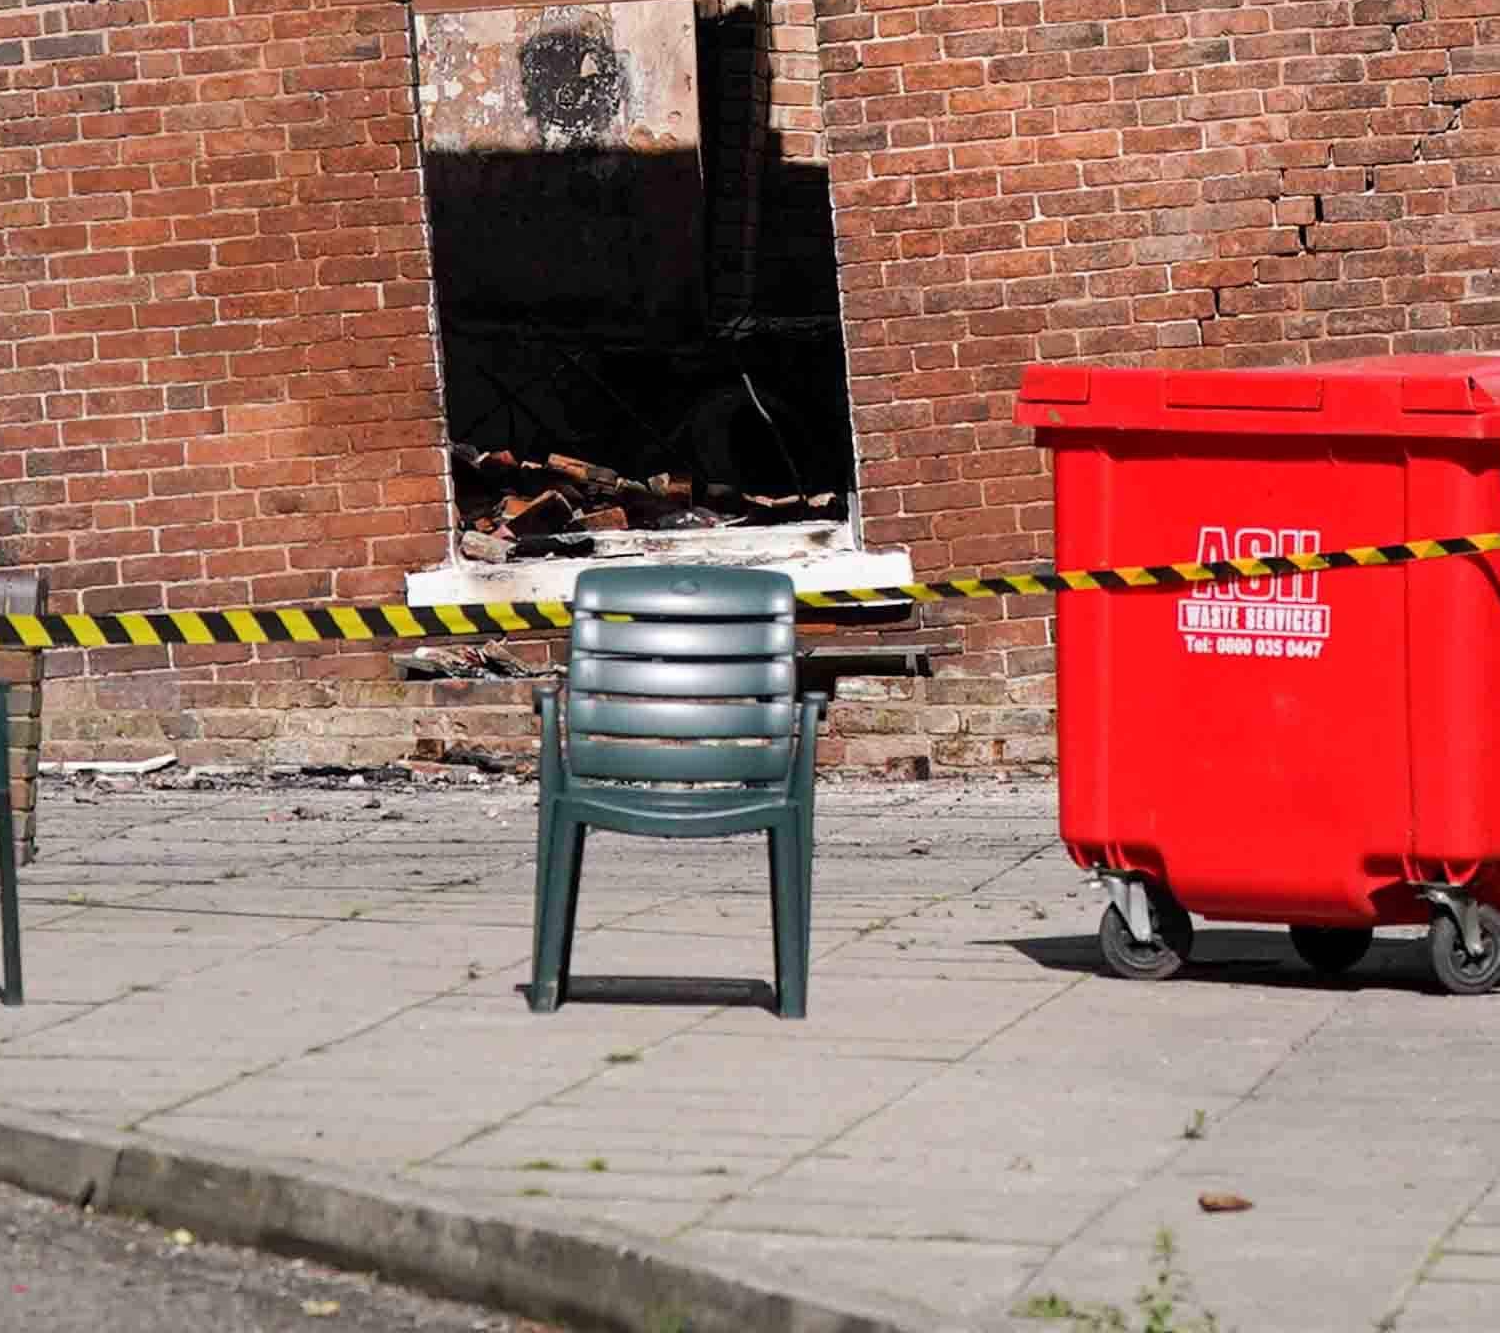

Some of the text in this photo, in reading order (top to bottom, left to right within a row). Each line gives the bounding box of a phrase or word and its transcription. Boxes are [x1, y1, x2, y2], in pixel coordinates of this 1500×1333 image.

[1191, 526, 1321, 604] ASH
[1186, 604, 1323, 633] WASTE SERVICES
[1184, 634, 1213, 653] Tel:
[1215, 636, 1252, 655] 0800
[1254, 638, 1283, 657] 035
